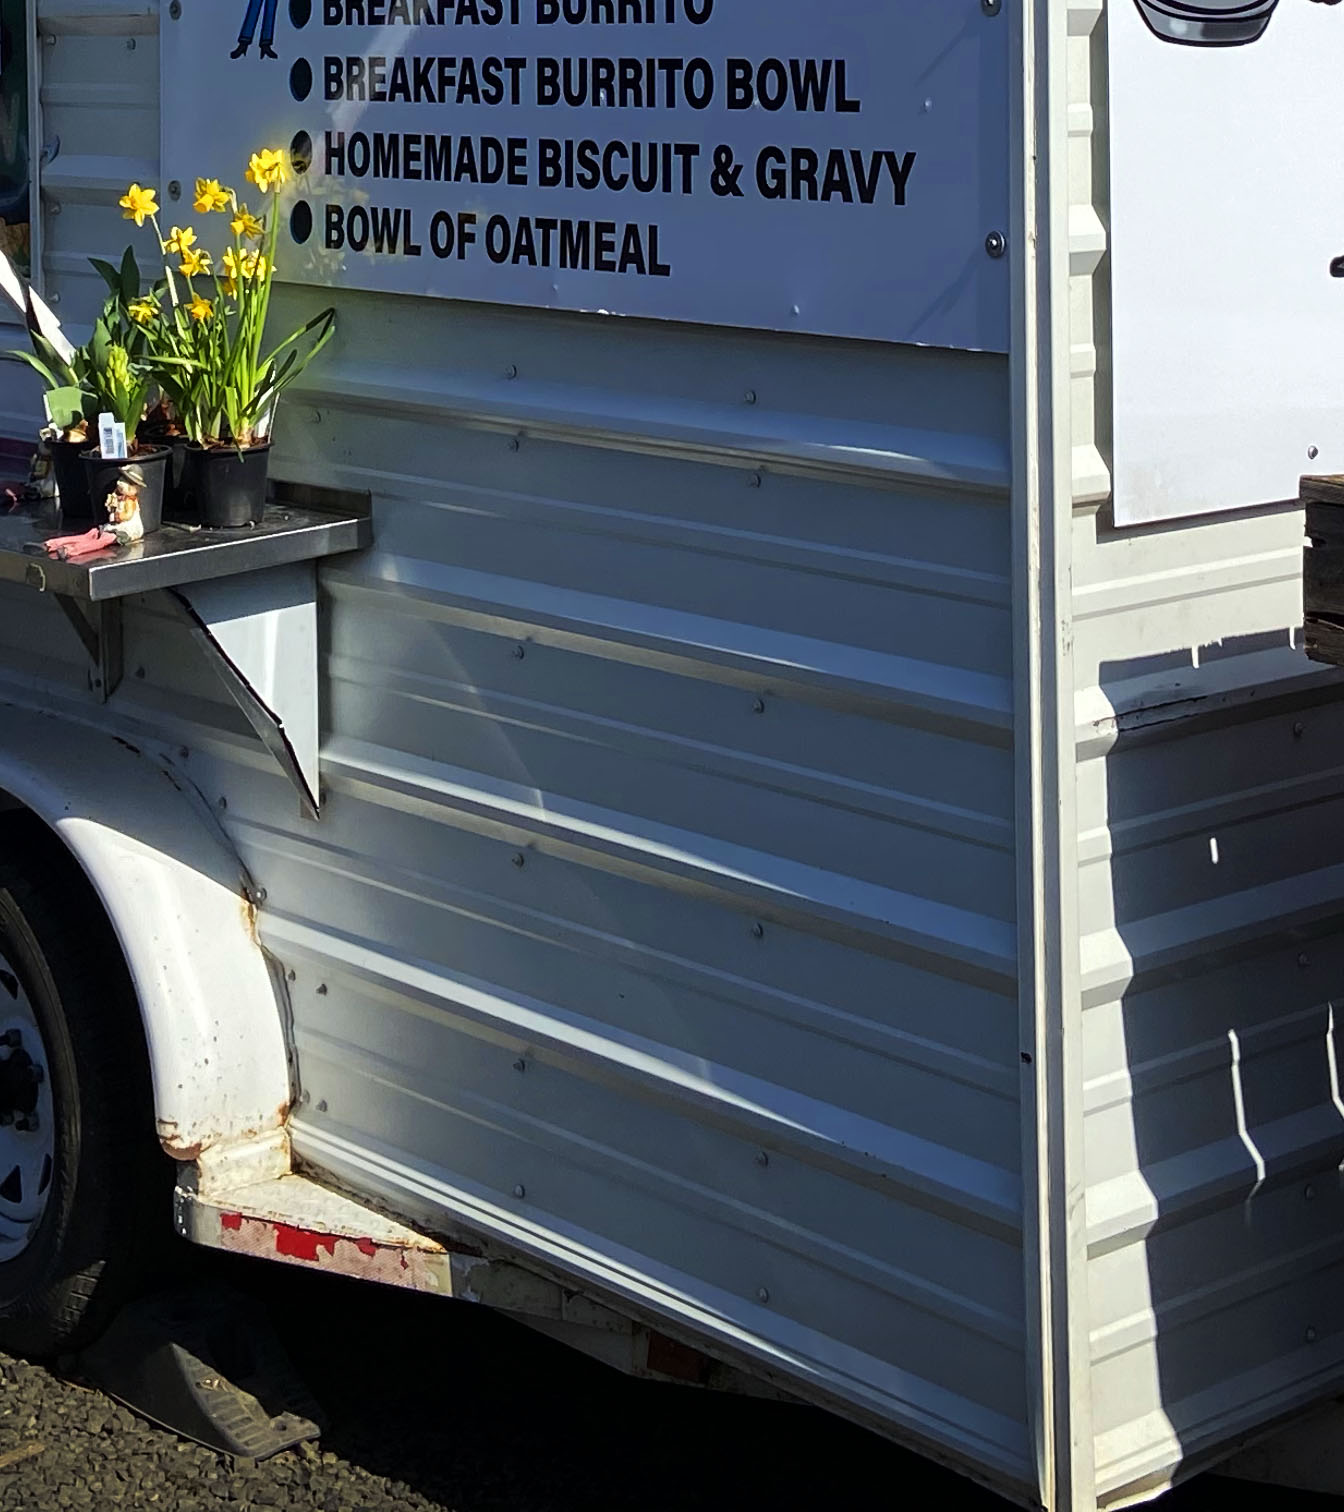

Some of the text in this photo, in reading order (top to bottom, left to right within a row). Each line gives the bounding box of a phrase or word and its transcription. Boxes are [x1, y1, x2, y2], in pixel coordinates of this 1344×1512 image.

[323, 57, 861, 114] BREAKFAST BURRITO BOWL
[324, 131, 916, 207] HOMEMADE BISCUIT & GRAVY
[325, 203, 671, 277] BOWL OF OATMEAL
